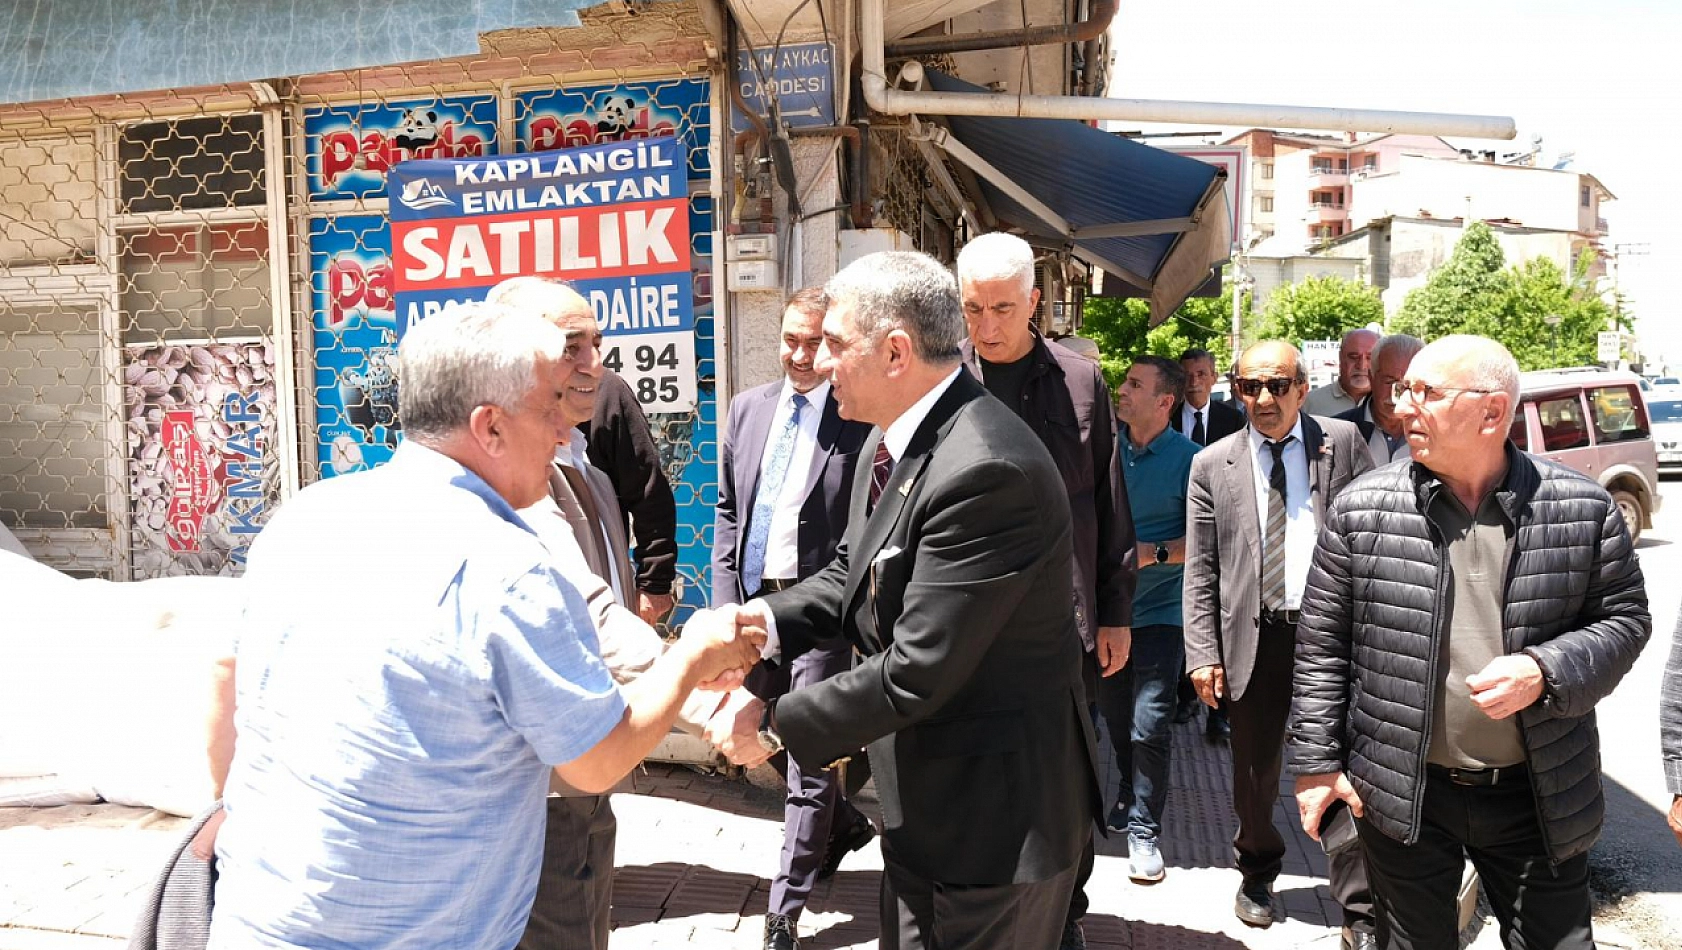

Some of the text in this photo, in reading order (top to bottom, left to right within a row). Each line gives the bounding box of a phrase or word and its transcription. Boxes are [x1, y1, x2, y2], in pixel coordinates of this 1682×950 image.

[454, 142, 673, 186] KAPLANGİL
[462, 174, 670, 214] EMLAKTAN
[403, 206, 679, 282] SATILIK
[590, 276, 681, 331] DAİRE
[635, 343, 679, 372] 94
[636, 376, 679, 404] 85
